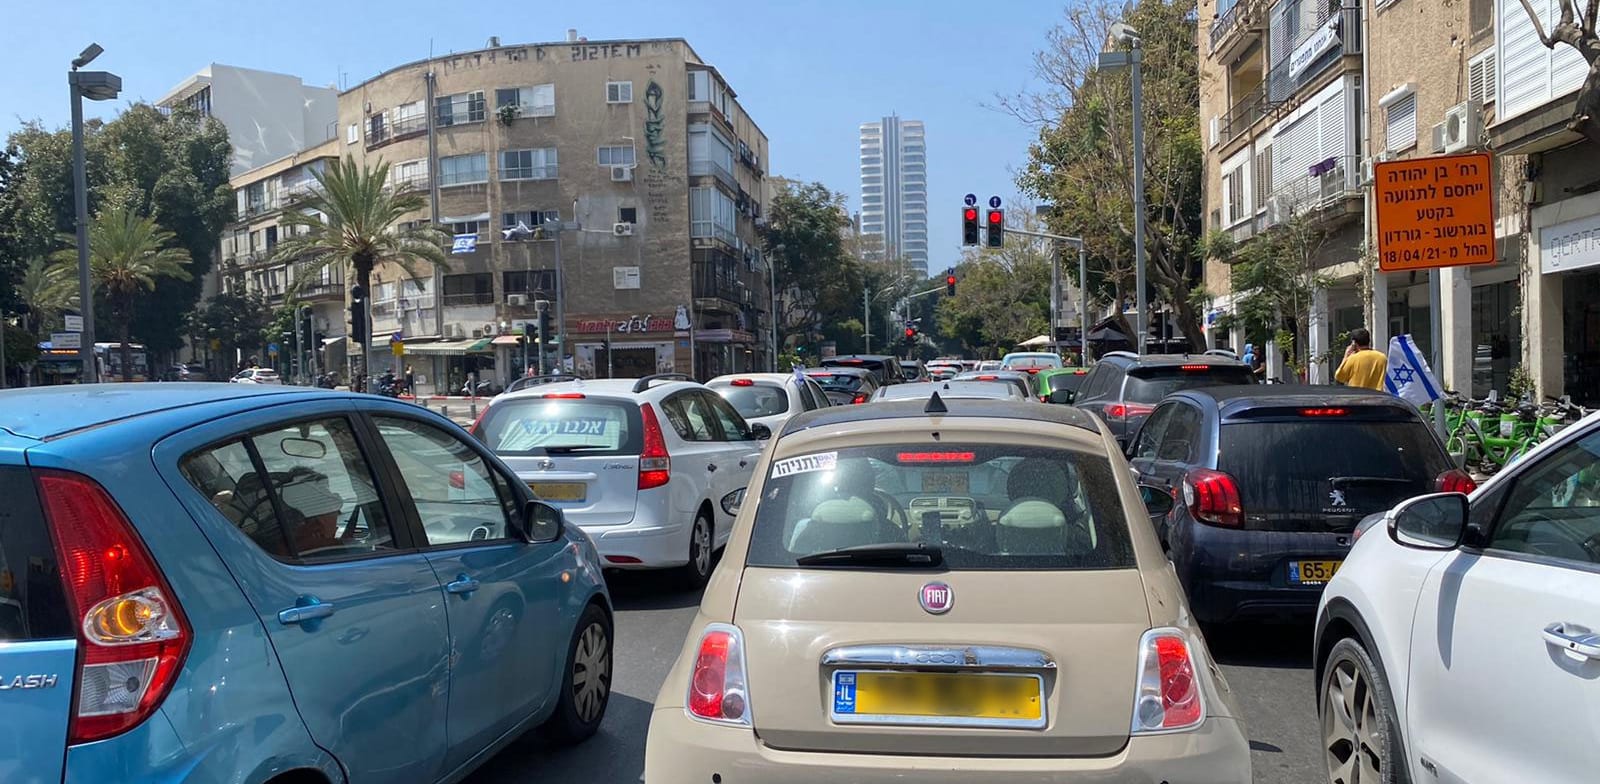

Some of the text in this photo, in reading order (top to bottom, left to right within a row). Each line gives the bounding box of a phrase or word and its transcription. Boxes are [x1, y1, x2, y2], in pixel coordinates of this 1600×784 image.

[1388, 168, 1427, 182] יהודה
[1434, 166, 1448, 182] בן
[1384, 183, 1483, 204] ייחסם לתנועה
[1416, 206, 1454, 221] בקטע
[1385, 229, 1421, 246] גורדון
[1433, 223, 1487, 239] בוגרשוב
[1463, 242, 1487, 256] החל
[776, 456, 822, 475] נתניהו
[926, 589, 947, 604] FIAT
[841, 684, 852, 701] IL
